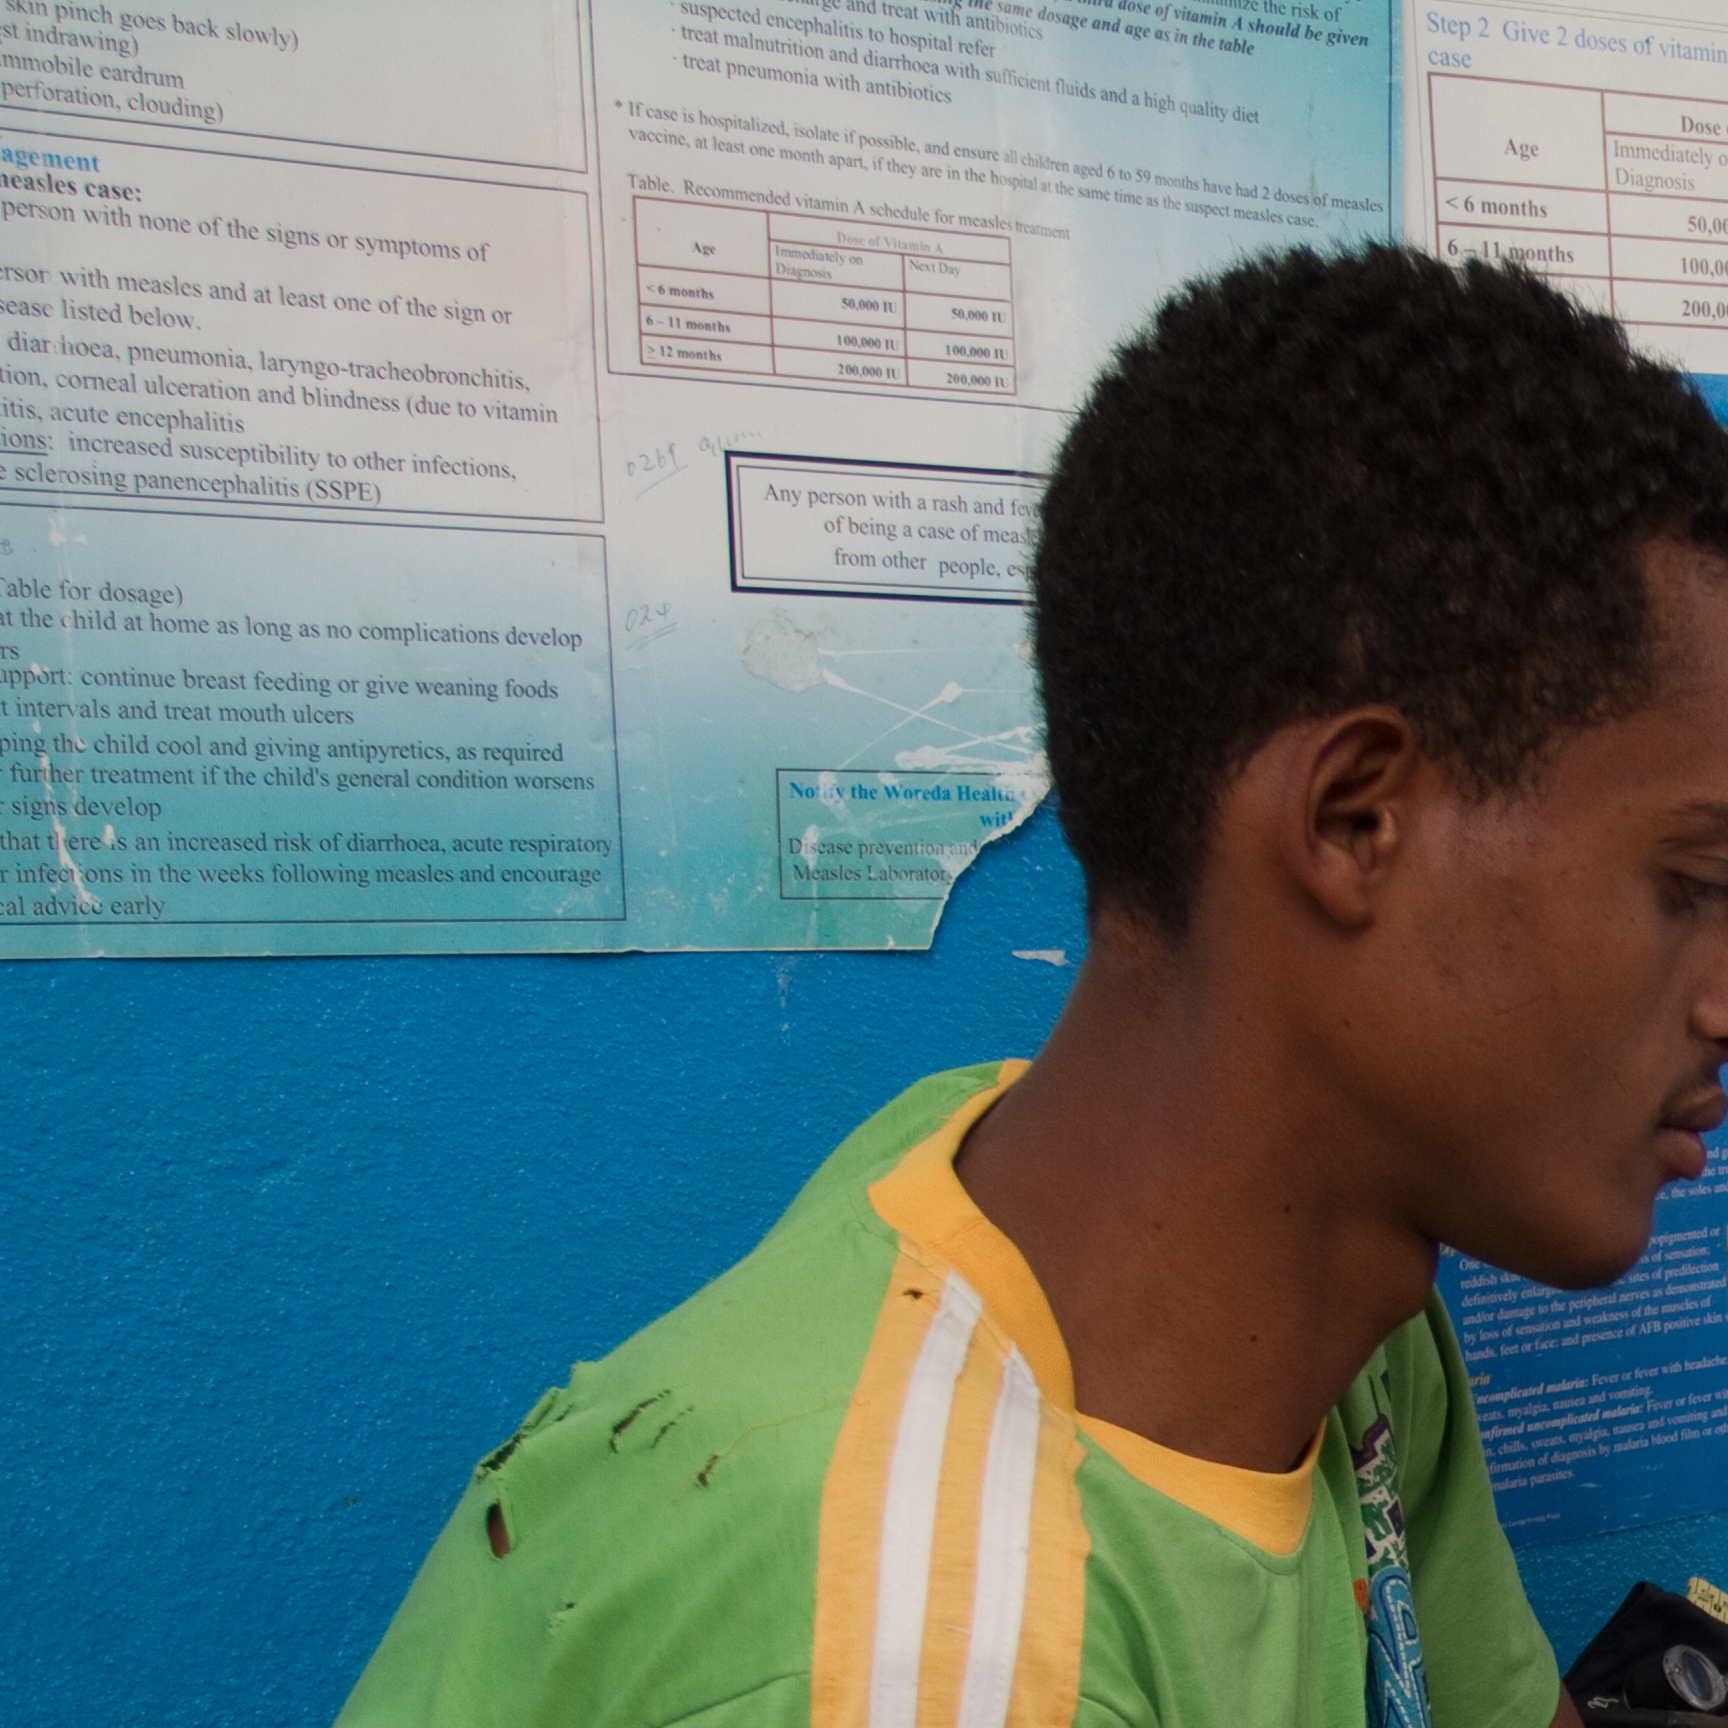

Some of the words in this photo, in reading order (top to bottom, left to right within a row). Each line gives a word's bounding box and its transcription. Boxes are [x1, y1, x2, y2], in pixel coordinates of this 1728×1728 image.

[54, 0, 113, 25] pinch
[119, 12, 167, 33] goes
[171, 12, 220, 39] back
[225, 21, 299, 52] slowly)
[1426, 12, 1472, 42] Step
[1477, 17, 1491, 39] 2
[1501, 20, 1551, 45] Give
[1556, 25, 1568, 47] 2
[1573, 27, 1628, 54] doses
[1632, 34, 1656, 56] of
[1658, 37, 1728, 65] vitamin
[1427, 50, 1472, 70] case
[682, 53, 721, 74] treat
[725, 61, 819, 87] pneumonia
[823, 72, 861, 93] with
[865, 79, 953, 104] antibiotics
[0, 80, 122, 111] perforation,
[126, 91, 224, 124] clouding)
[1680, 115, 1722, 136] Dose
[1504, 138, 1539, 161] Age
[1613, 139, 1714, 169] Immediately
[1614, 166, 1696, 192] Diagnosis
[626, 174, 675, 196] Table.
[683, 180, 791, 207] Recommended
[794, 193, 849, 214] vitamin
[853, 199, 866, 216] A
[869, 202, 930, 223] schedule
[933, 208, 955, 226] for
[958, 214, 1013, 231] measles
[1014, 219, 1071, 240] treatment
[0, 199, 76, 223] person
[82, 205, 133, 228] with
[137, 214, 192, 234] none
[196, 216, 224, 237] of
[226, 217, 260, 241] the
[265, 222, 321, 249] signs
[325, 233, 350, 250] or
[355, 236, 461, 260] symptoms
[466, 242, 491, 263] of
[692, 241, 717, 257] Age
[6, 330, 121, 361] diarhoea,
[127, 345, 254, 373] pneumonia,
[259, 350, 531, 393] laryngo-tracheobronchitis,
[68, 430, 174, 458] increased
[179, 443, 321, 472] susceptibility
[326, 451, 348, 469] to
[352, 450, 407, 473] other
[411, 453, 517, 483] infections,
[14, 463, 129, 491] sclerosing
[133, 473, 300, 498] panencephalitis
[305, 479, 382, 502] (SSPE)
[764, 484, 802, 508] Any
[807, 490, 867, 509] person
[872, 491, 912, 510] with
[917, 497, 928, 511] a
[932, 495, 968, 514] rash
[973, 497, 1005, 516] and
[834, 548, 877, 568] from
[881, 552, 928, 570] other
[938, 557, 1002, 579] people,
[80, 666, 176, 689] continue
[181, 668, 247, 691] breast
[253, 670, 332, 698] feeding
[337, 678, 360, 694] or
[365, 674, 410, 699] give
[414, 677, 499, 702] weaning
[504, 678, 559, 699] foods
[792, 863, 862, 882] Measles
